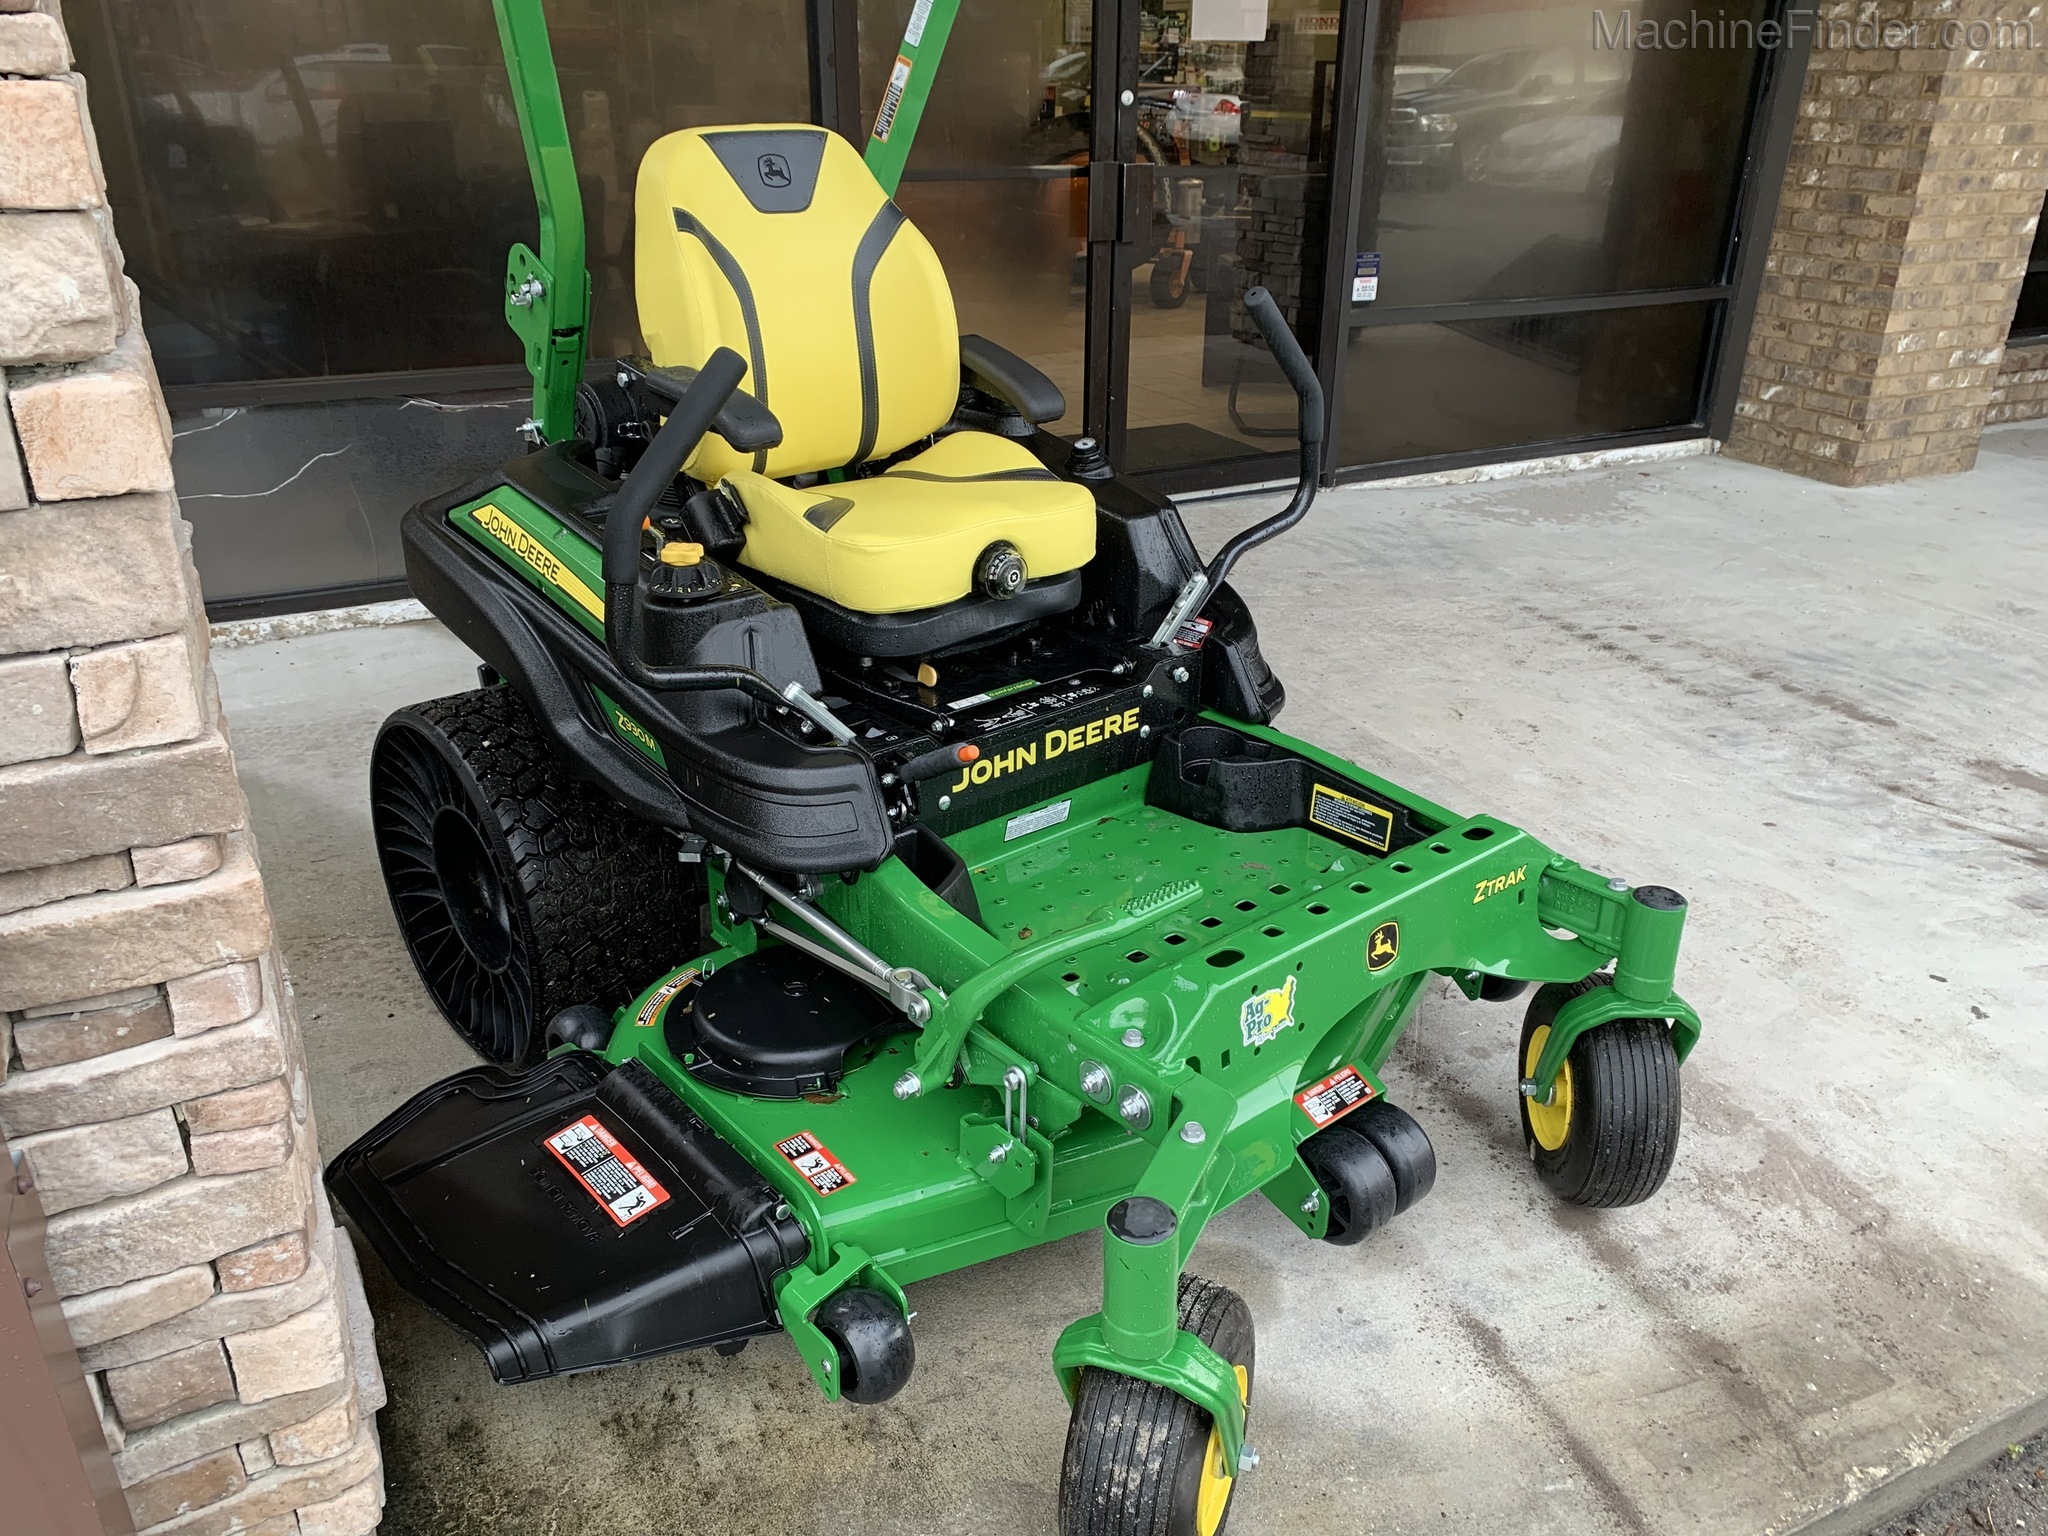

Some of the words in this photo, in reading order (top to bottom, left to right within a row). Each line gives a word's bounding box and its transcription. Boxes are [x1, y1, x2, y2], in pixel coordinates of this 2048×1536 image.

[1299, 16, 1340, 25] HOND
[484, 509, 517, 547] JOHN
[518, 535, 560, 583] DEERE
[952, 742, 1037, 794] JOHN
[1045, 706, 1141, 760] DEERE
[1473, 864, 1528, 905] ZTRAK
[1246, 1013, 1272, 1040] Pro
[595, 1127, 618, 1148] DANGER
[631, 1165, 657, 1190] PELIGRO
